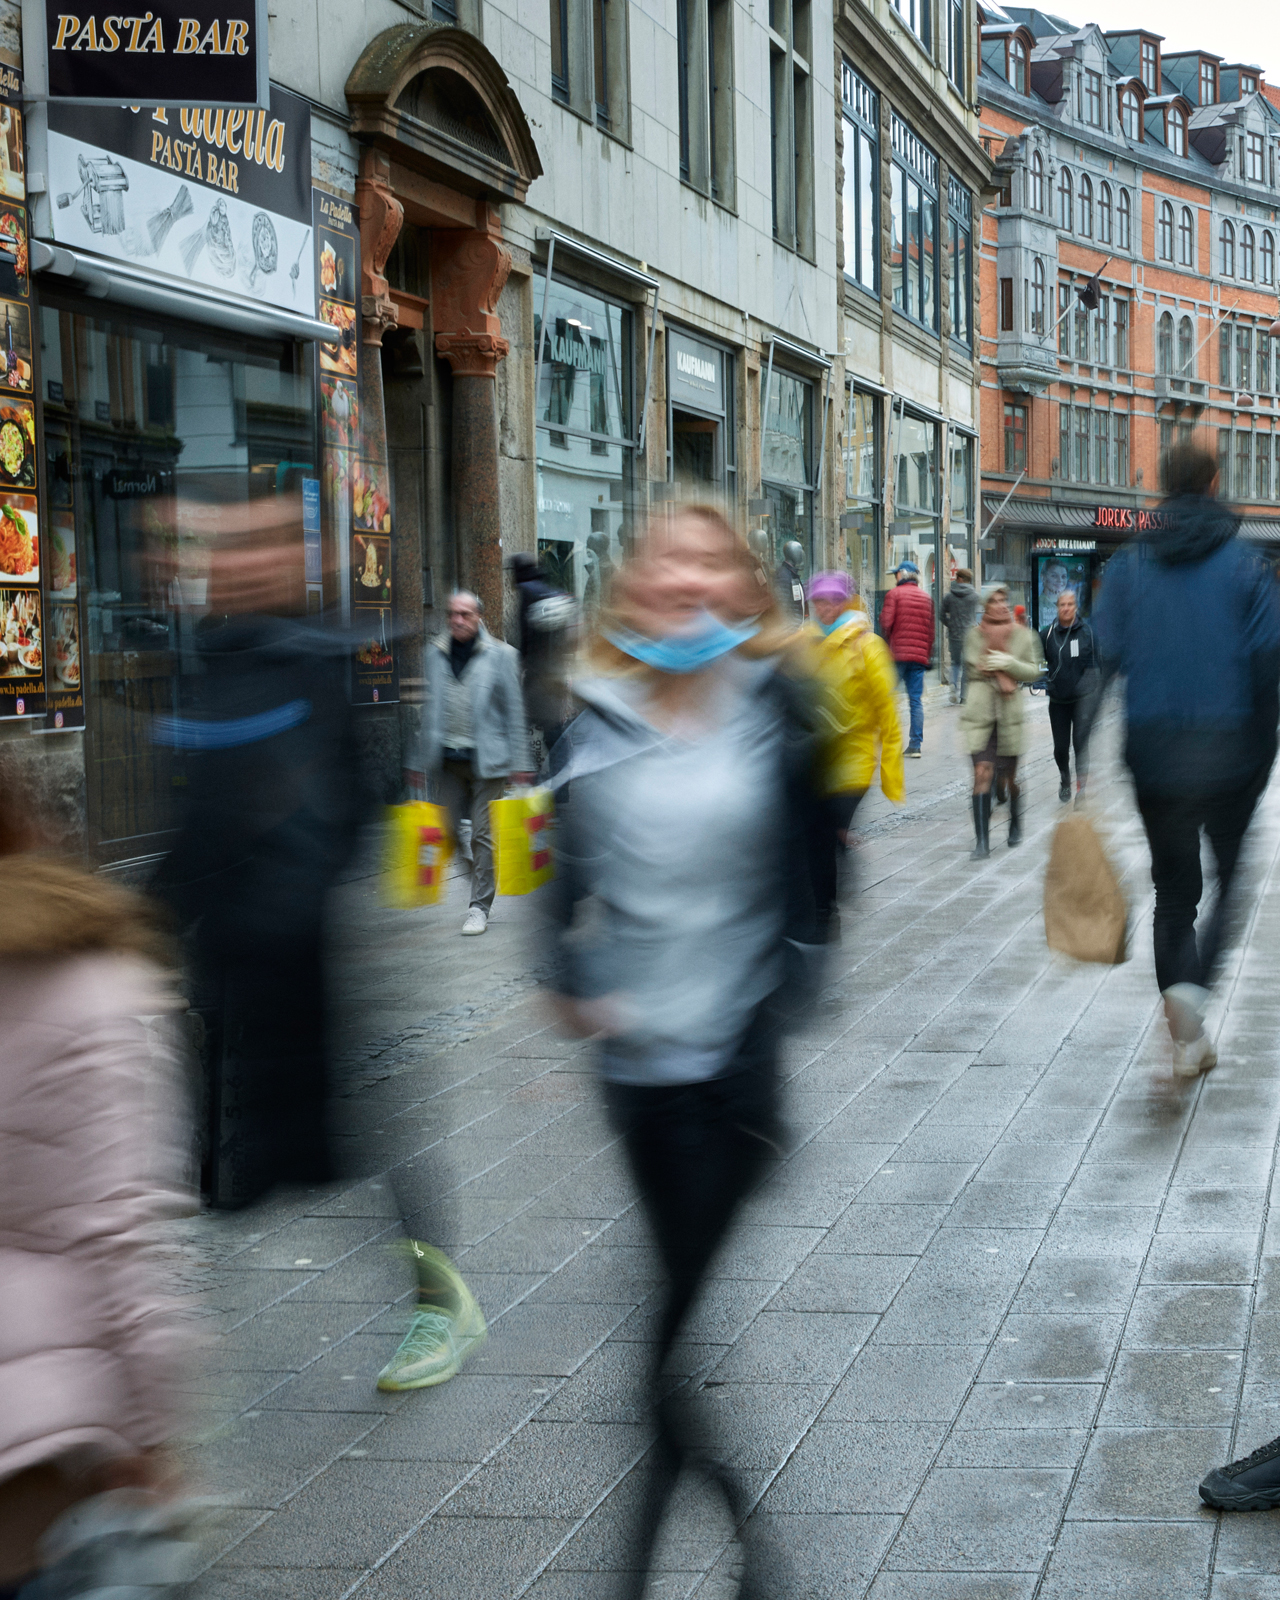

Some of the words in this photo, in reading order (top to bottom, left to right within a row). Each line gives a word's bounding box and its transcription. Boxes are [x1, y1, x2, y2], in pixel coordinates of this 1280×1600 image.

[52, 11, 165, 53] PASTA
[173, 18, 249, 56] BAR
[152, 107, 285, 173] aella
[151, 130, 203, 180] PASTA
[206, 152, 239, 194] BAR
[550, 334, 607, 376] KAUFMANN
[676, 350, 715, 384] KAUFMANN
[1095, 506, 1133, 528] JORCKS
[1137, 510, 1181, 531] PASSAG
[16, 681, 45, 698] padella.dk
